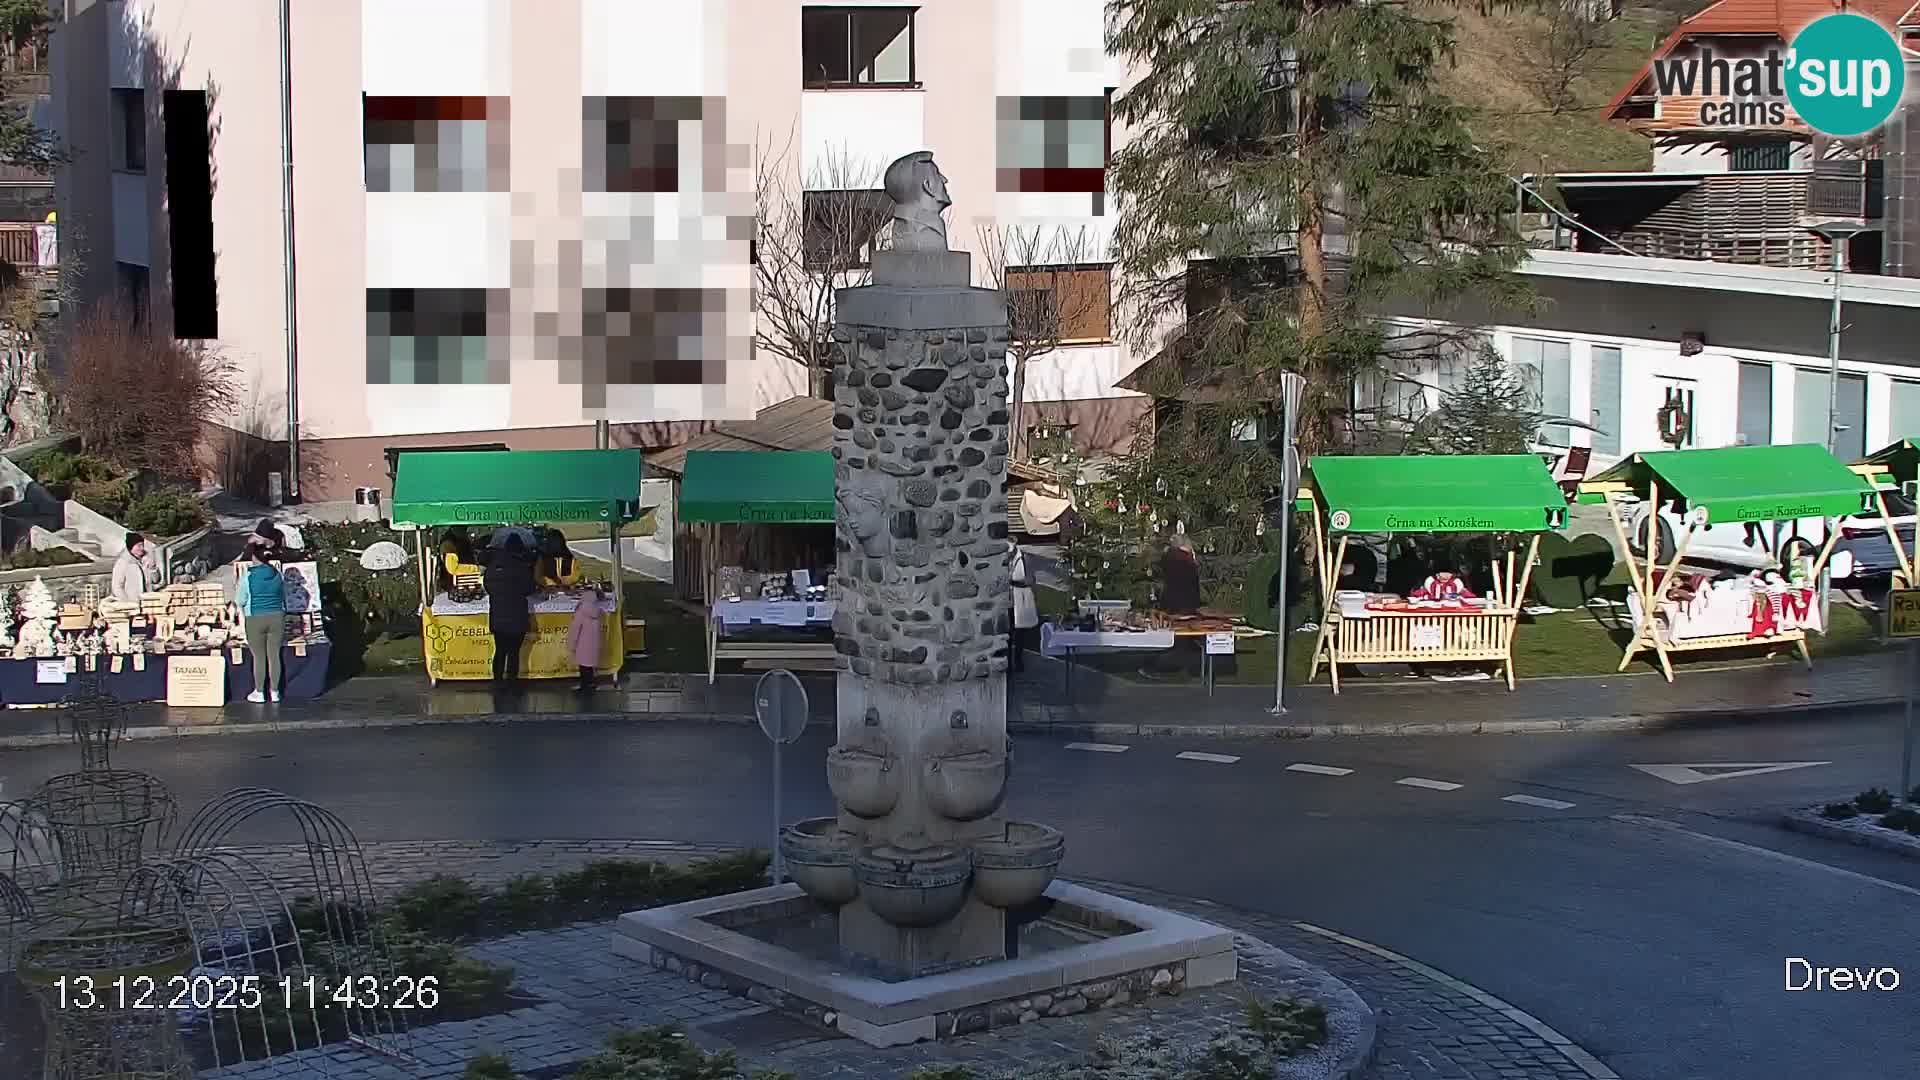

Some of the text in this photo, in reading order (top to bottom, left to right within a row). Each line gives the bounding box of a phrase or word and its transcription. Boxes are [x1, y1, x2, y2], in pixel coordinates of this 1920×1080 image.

[1385, 513, 1495, 528] Črna na Koroškem
